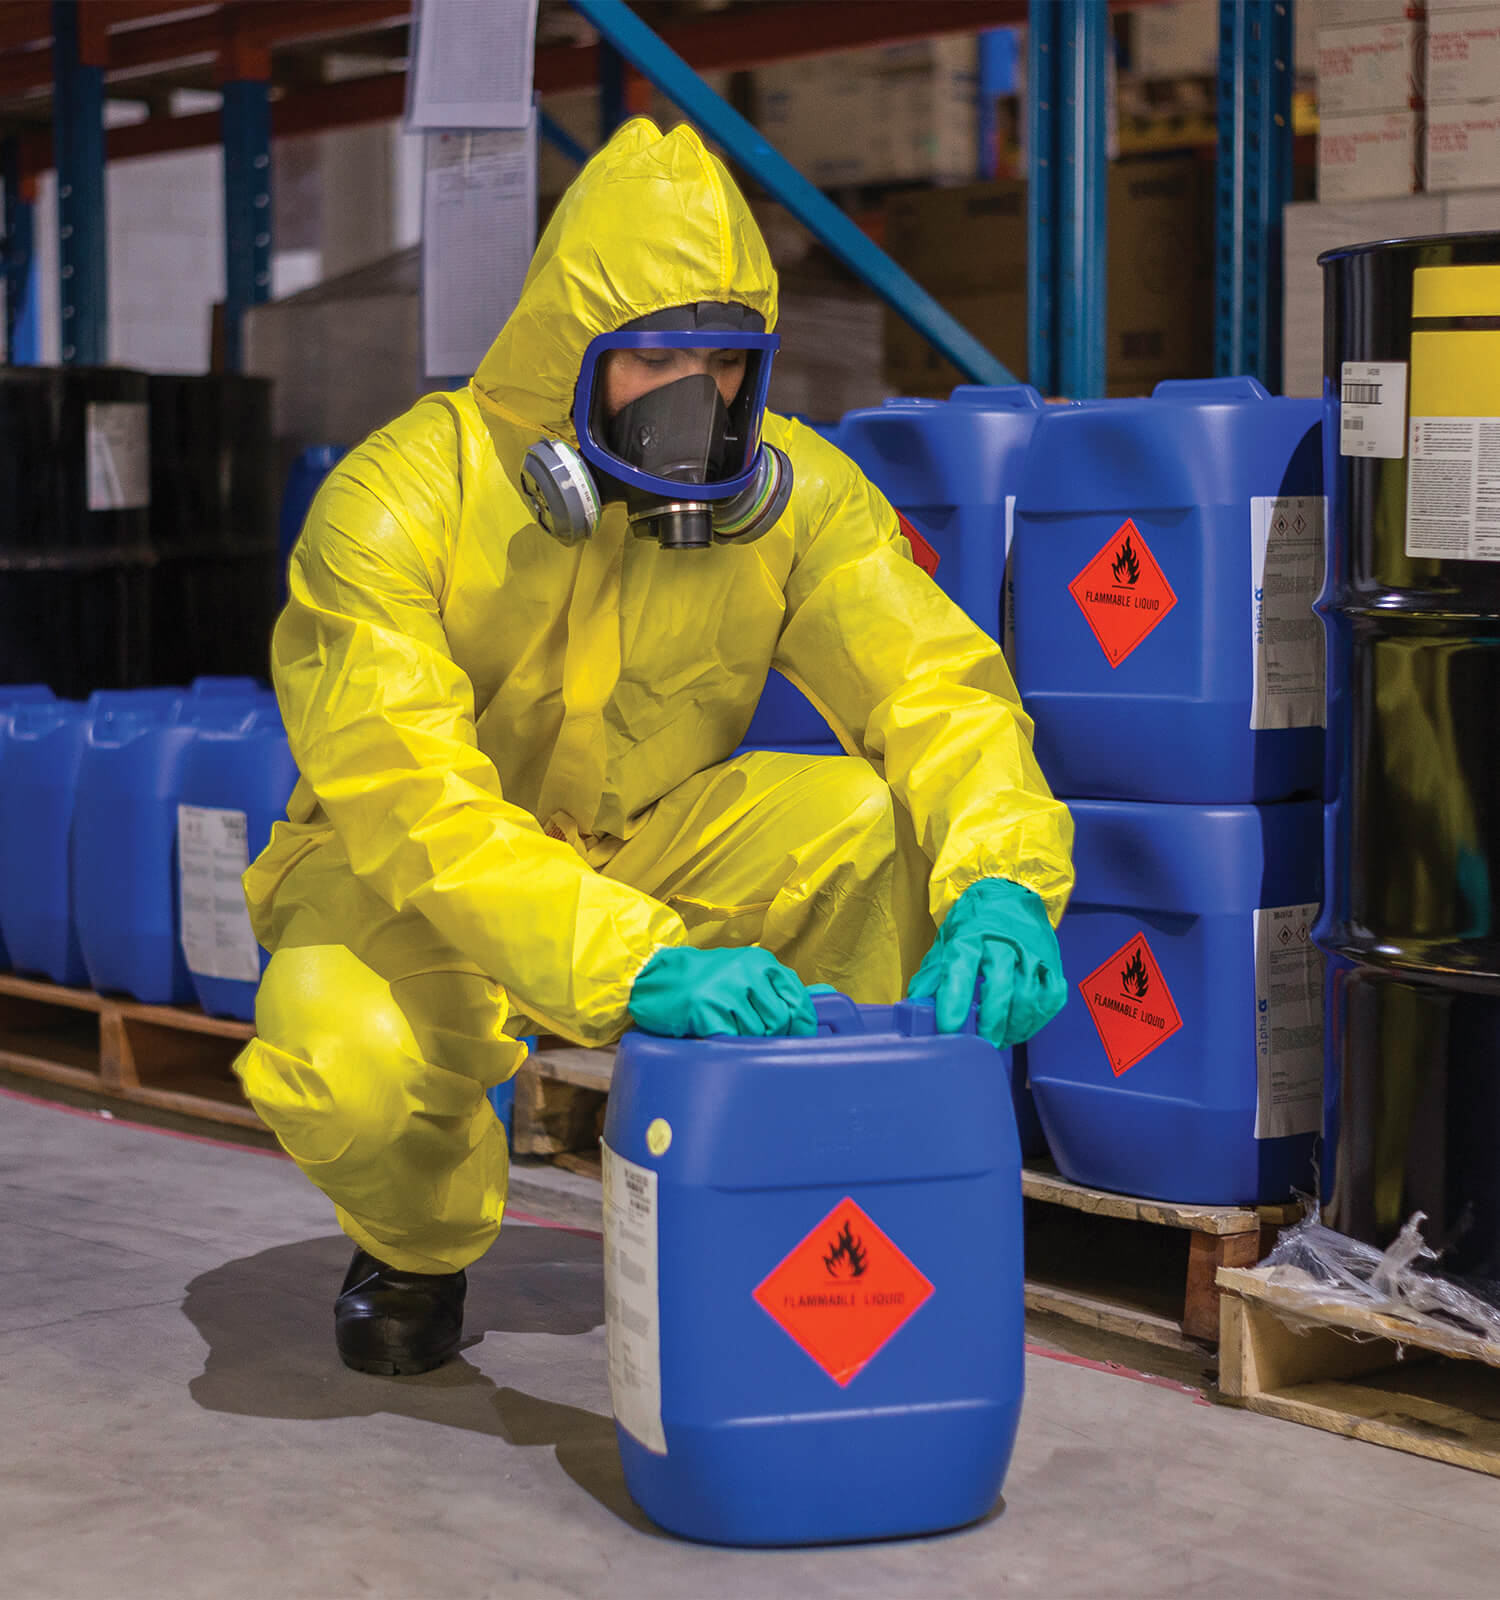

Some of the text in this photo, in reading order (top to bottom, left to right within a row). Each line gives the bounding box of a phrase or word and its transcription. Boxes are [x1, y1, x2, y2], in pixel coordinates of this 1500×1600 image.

[1085, 591, 1160, 611] FLAMMABLE LIQUID
[1255, 604, 1264, 645] alpha
[1094, 993, 1166, 1030] FLAMMABLE LIQUID
[1258, 1016, 1268, 1055] alpha
[784, 1291, 905, 1308] FLAMMABLE LIQUID
